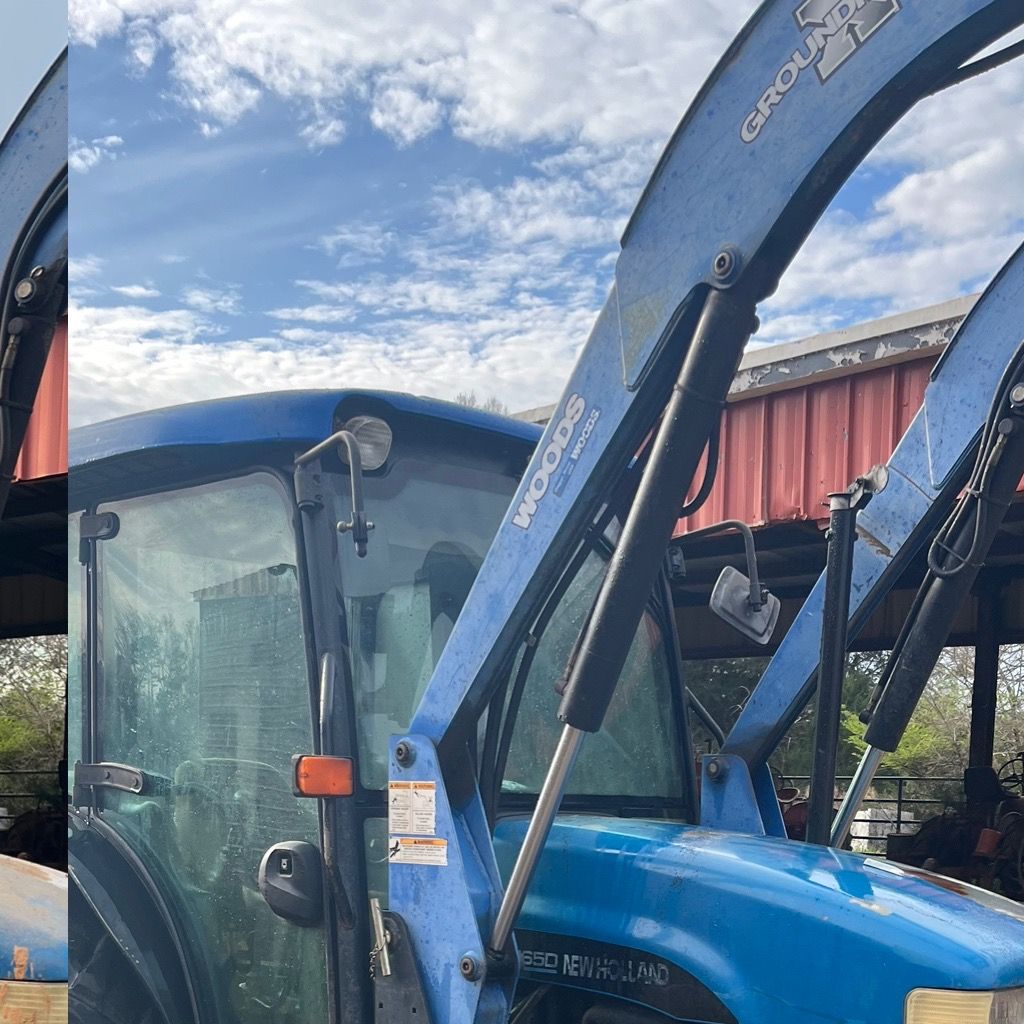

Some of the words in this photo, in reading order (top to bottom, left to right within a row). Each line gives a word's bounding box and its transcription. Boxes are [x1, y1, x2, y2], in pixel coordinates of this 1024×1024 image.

[740, 0, 870, 144] GROUND
[512, 393, 586, 530] WOODS
[563, 953, 594, 978] NEW
